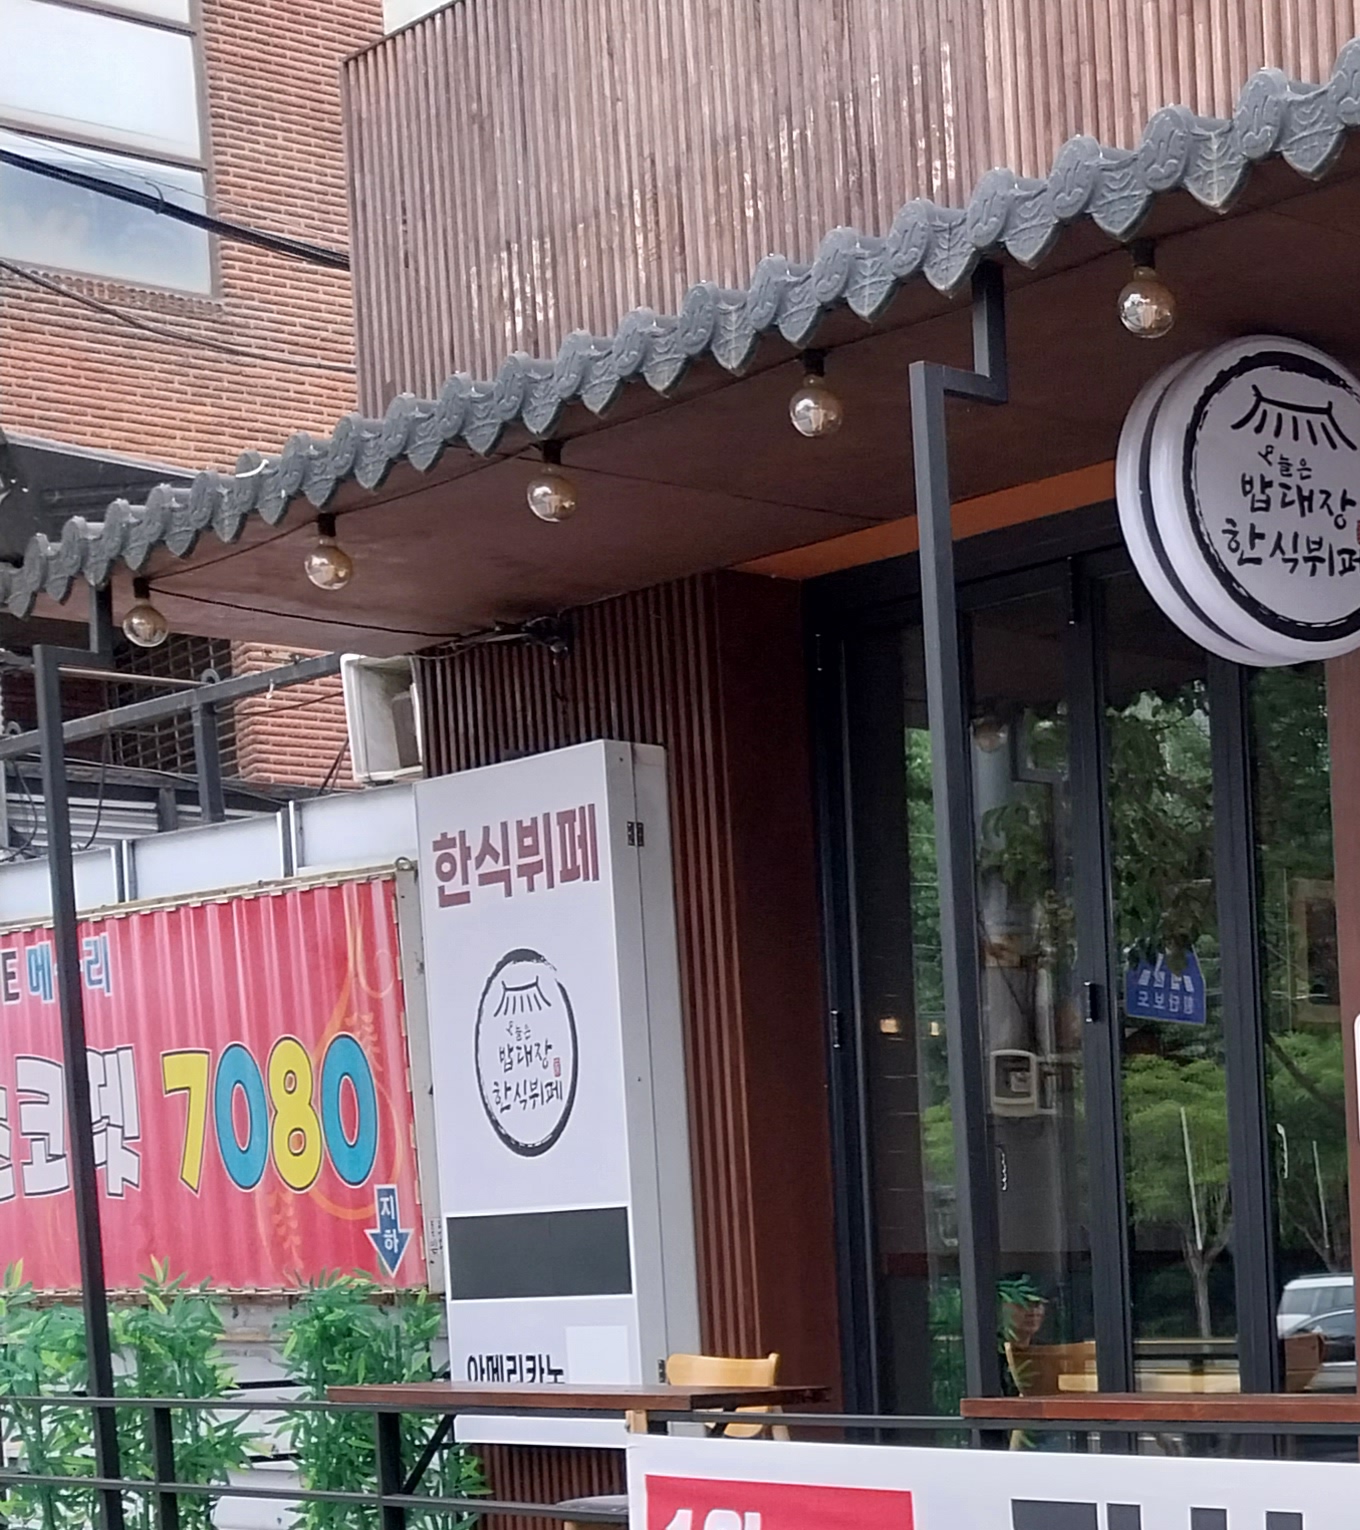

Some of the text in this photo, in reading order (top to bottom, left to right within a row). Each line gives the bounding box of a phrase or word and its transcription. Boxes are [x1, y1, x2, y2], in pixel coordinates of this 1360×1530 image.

[1258, 444, 1312, 480] 오늘은
[1241, 472, 1357, 529] 밥대장
[432, 803, 600, 908] 한식뷔페
[26, 932, 112, 1002] 메리
[499, 1038, 553, 1073] 밥대장
[161, 1032, 378, 1196] 7080
[492, 1077, 563, 1114] 한식뷔페
[379, 1194, 400, 1254] 지하
